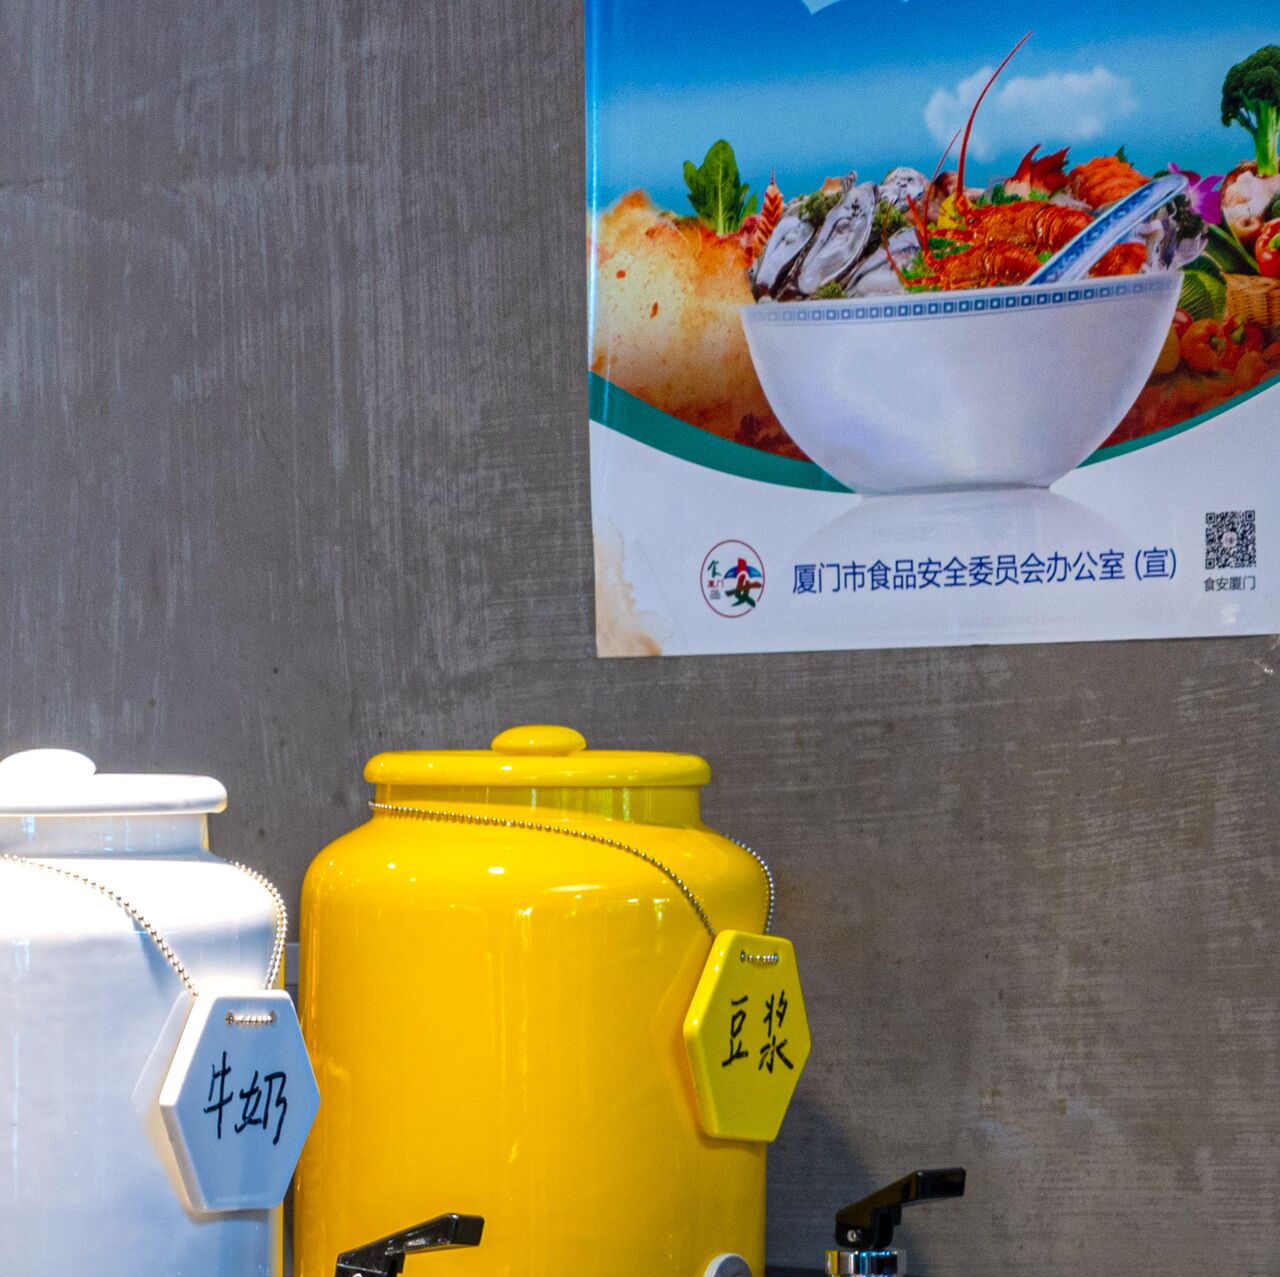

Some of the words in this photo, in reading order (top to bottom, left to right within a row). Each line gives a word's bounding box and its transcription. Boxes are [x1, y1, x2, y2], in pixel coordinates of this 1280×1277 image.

[1204, 575, 1256, 592] 食安厦门
[722, 989, 794, 1074] 豆浆
[203, 1051, 287, 1145] 牛奶
